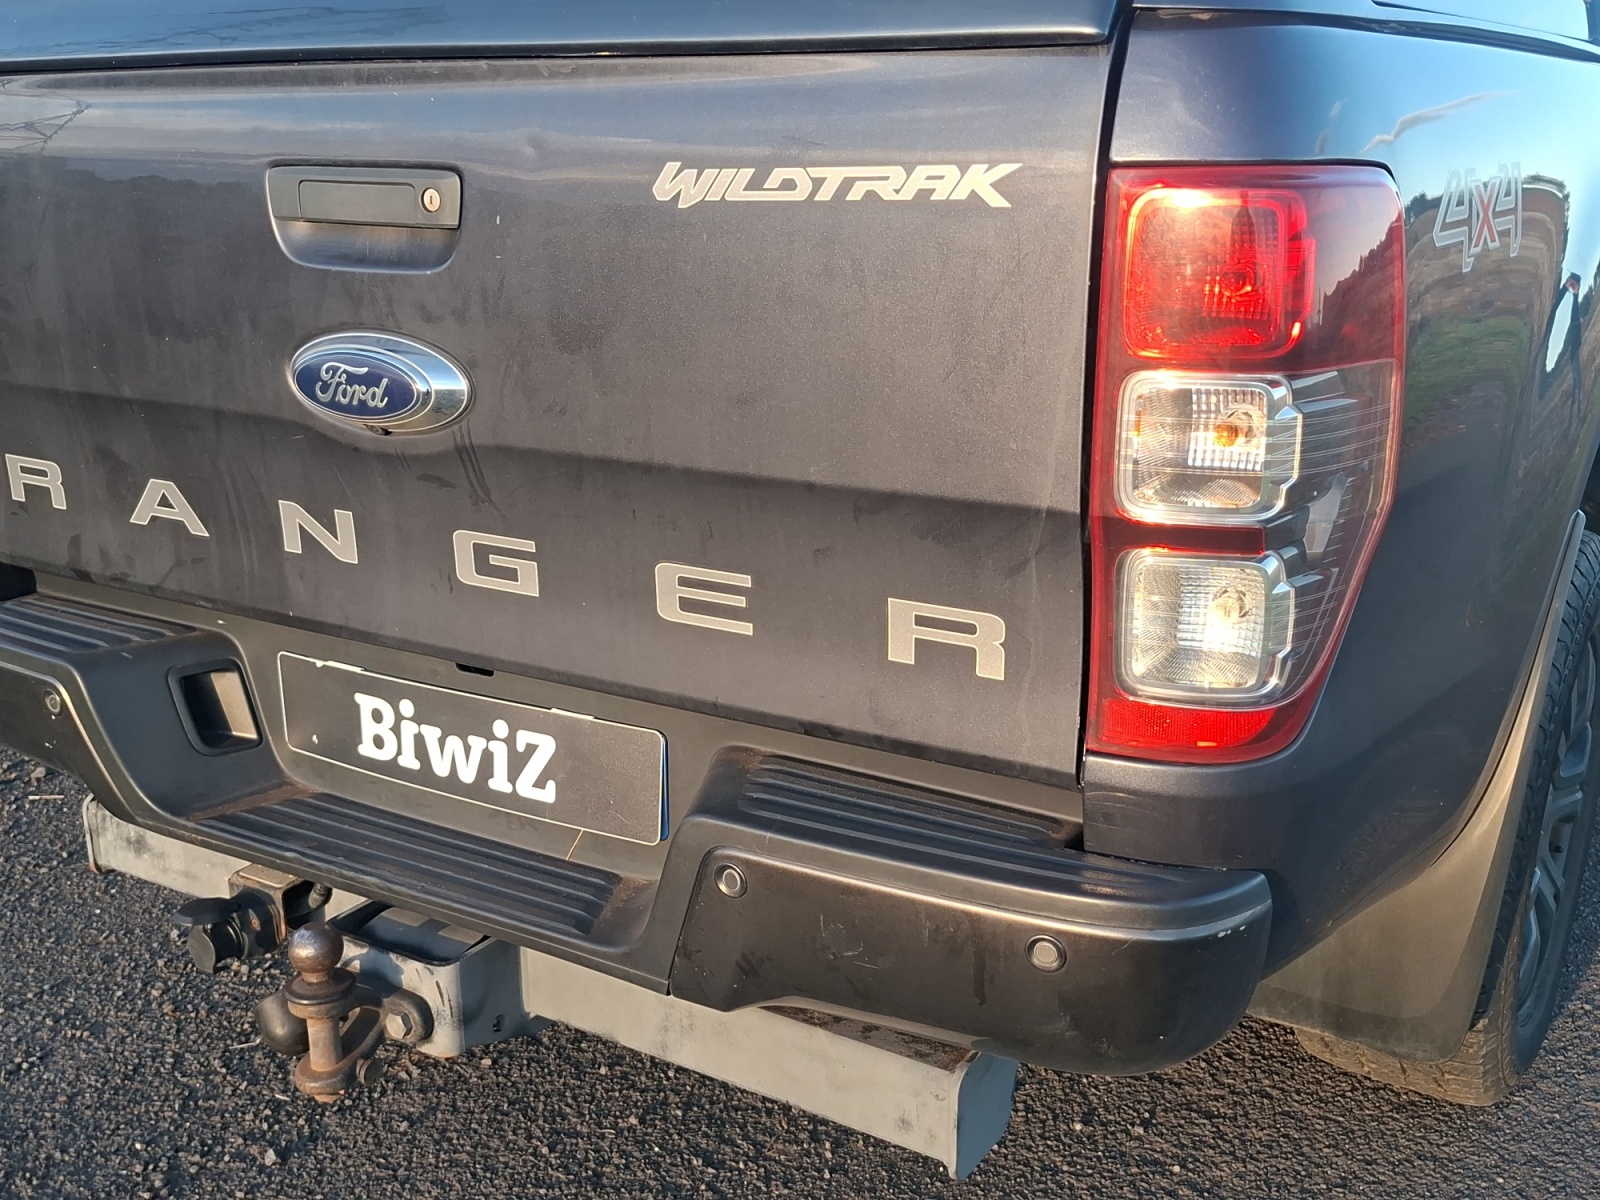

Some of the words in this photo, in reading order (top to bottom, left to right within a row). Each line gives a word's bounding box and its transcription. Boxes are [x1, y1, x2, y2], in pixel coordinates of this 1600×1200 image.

[651, 161, 1023, 208] WILDTRAK
[315, 361, 389, 408] Ford
[4, 453, 1007, 681] RANGER
